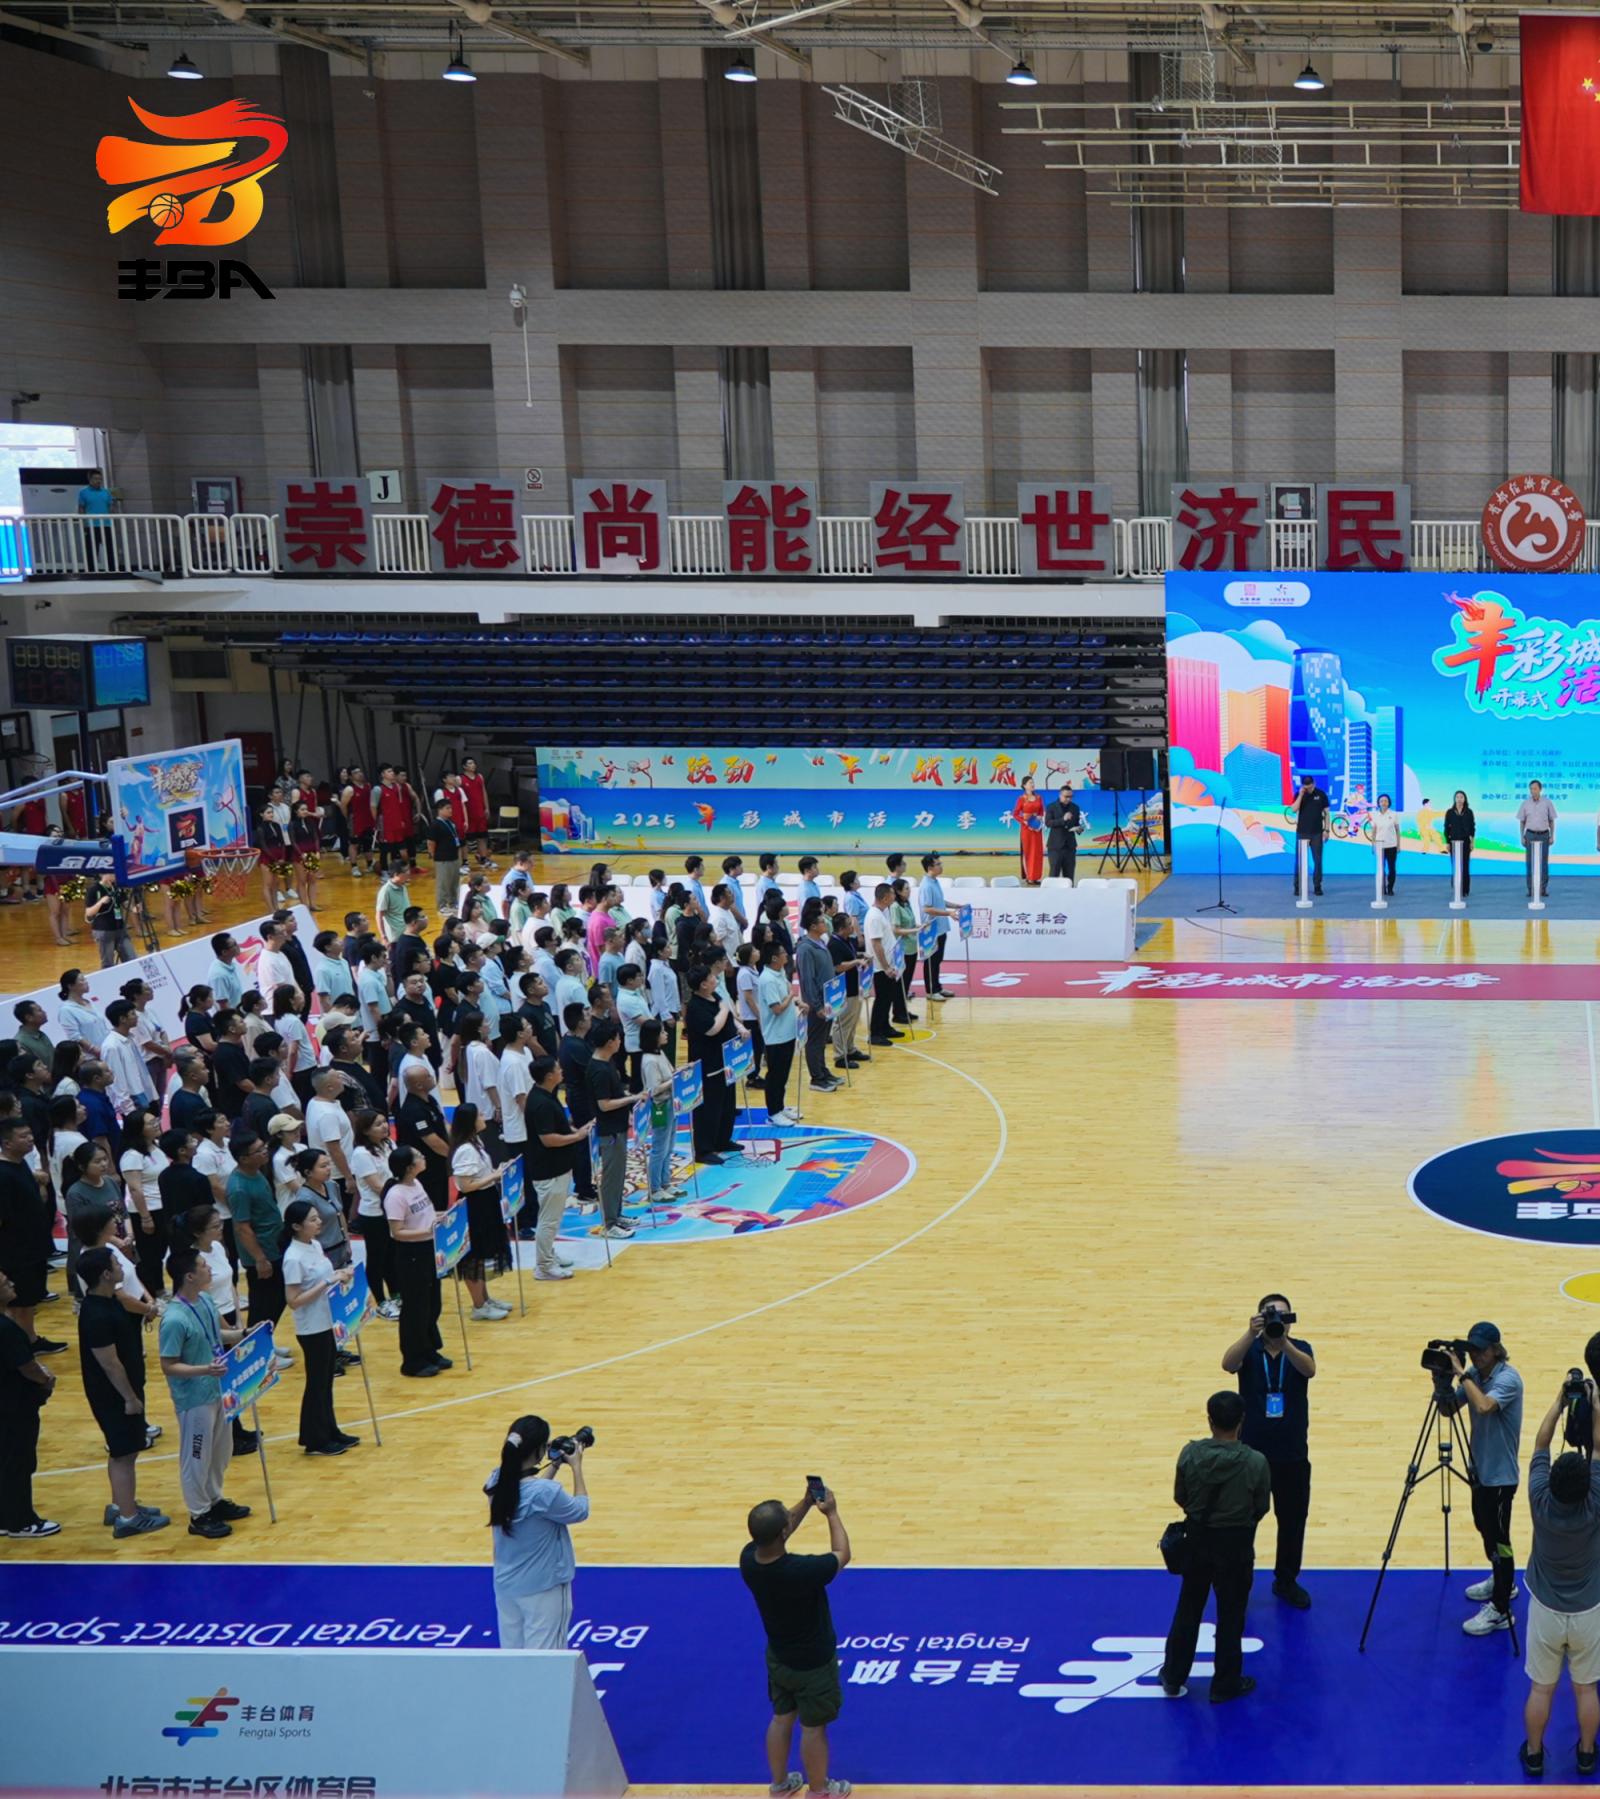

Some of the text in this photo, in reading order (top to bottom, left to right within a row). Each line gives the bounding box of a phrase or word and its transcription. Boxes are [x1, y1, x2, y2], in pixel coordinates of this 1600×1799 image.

[377, 475, 390, 500] J
[283, 481, 1404, 571] 崇德尚能经世济民
[1491, 686, 1550, 711] 开幕式
[997, 912, 1069, 926] 北京丰台
[998, 928, 1067, 936] FENGTAI BEIJING
[294, 1617, 473, 1647] Fengtai
[567, 1619, 649, 1649] Beij
[836, 1632, 1030, 1652] Fengtai Spor
[838, 1659, 1021, 1685] 丰台体
[241, 1704, 315, 1722] 丰台体育
[239, 1727, 311, 1738] Fengtai Sports
[100, 1775, 377, 1799] 北京市丰台区体育局
